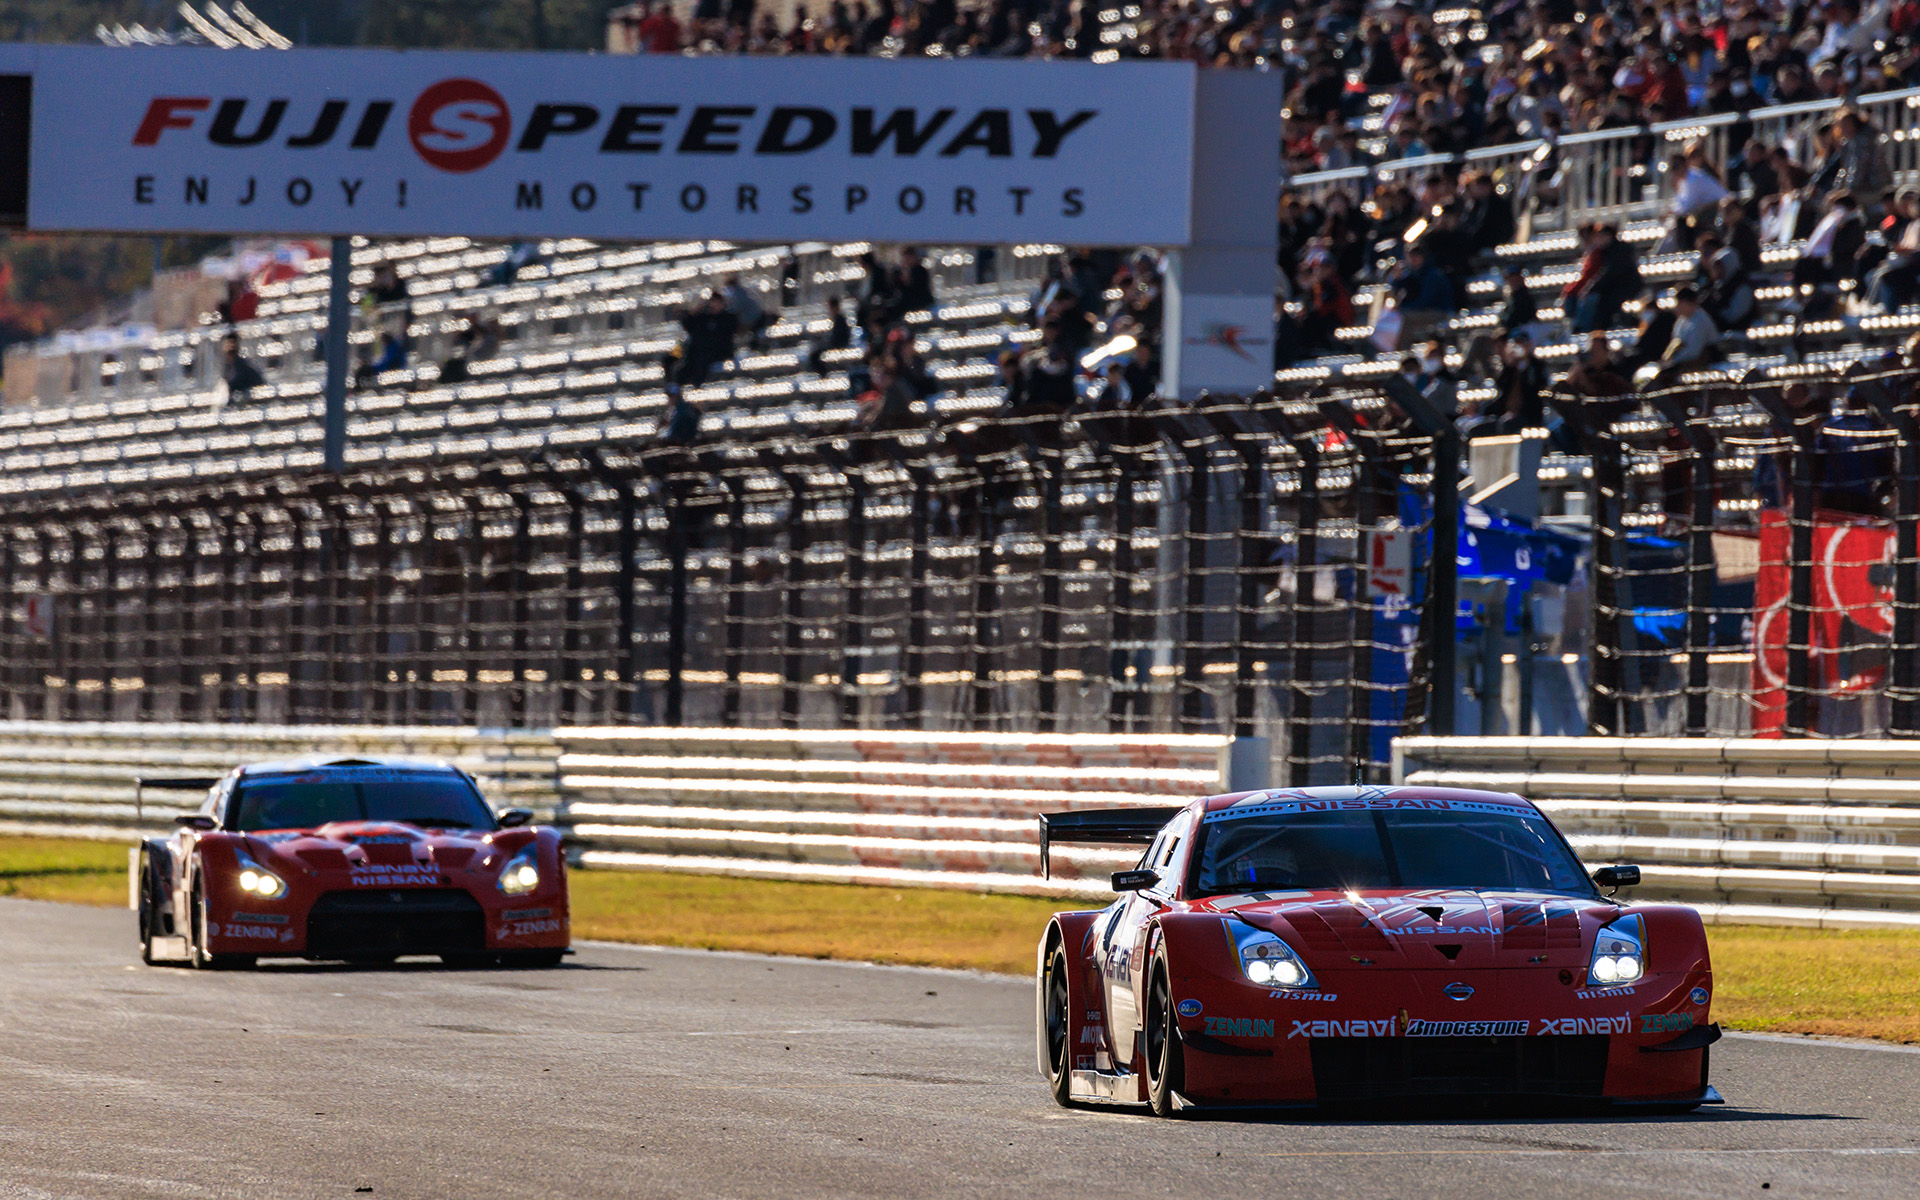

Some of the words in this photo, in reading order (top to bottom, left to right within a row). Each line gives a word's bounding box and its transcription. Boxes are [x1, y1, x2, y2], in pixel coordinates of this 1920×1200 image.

[132, 96, 395, 148] FUJI
[135, 176, 408, 207] ENJOY!
[516, 181, 1086, 218] MOTORSPORTS
[1213, 806, 1283, 818] nismo
[1300, 799, 1451, 811] NISSAN
[1463, 803, 1529, 814] nismo
[352, 875, 437, 885] NISSAN
[1384, 926, 1501, 936] NISSAN
[1270, 990, 1337, 1001] nismo
[1577, 986, 1634, 1000] nismo
[1204, 1017, 1274, 1037] ZENRIN
[1406, 1019, 1529, 1037] BRIDGESTONE
[1641, 1012, 1693, 1033] ZENRIN
